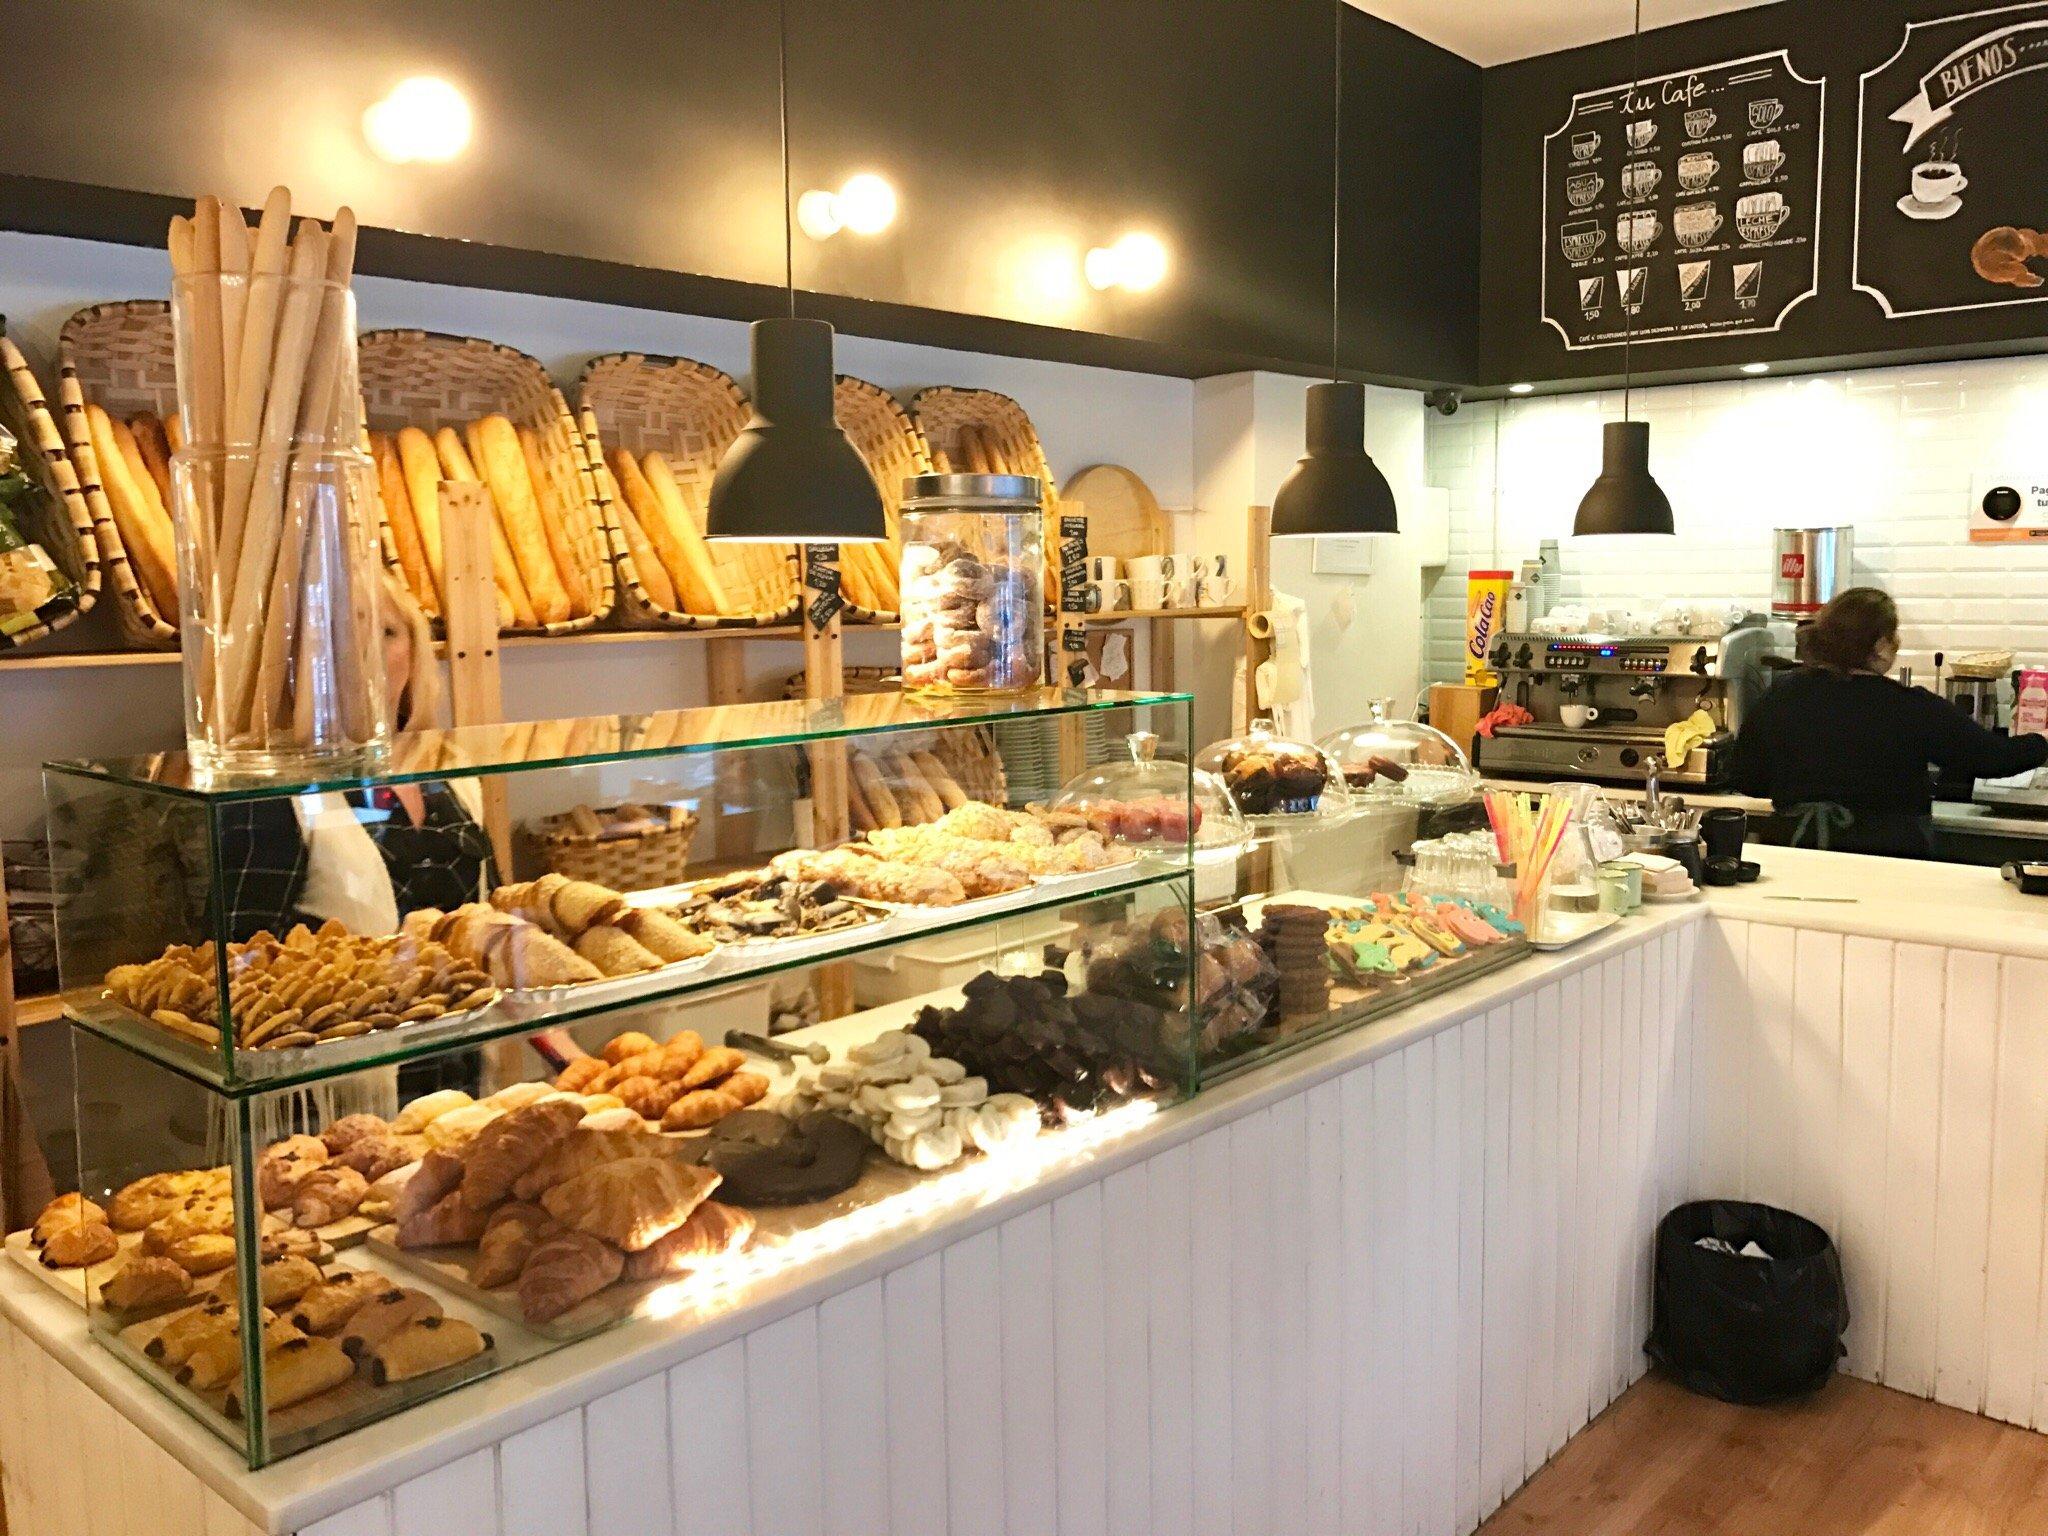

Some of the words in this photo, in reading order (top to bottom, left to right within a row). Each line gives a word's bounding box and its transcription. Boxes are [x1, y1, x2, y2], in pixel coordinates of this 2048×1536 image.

[1751, 103, 1775, 124] SOLO
[1584, 309, 1600, 321] 1,50
[1783, 557, 1803, 577] illy
